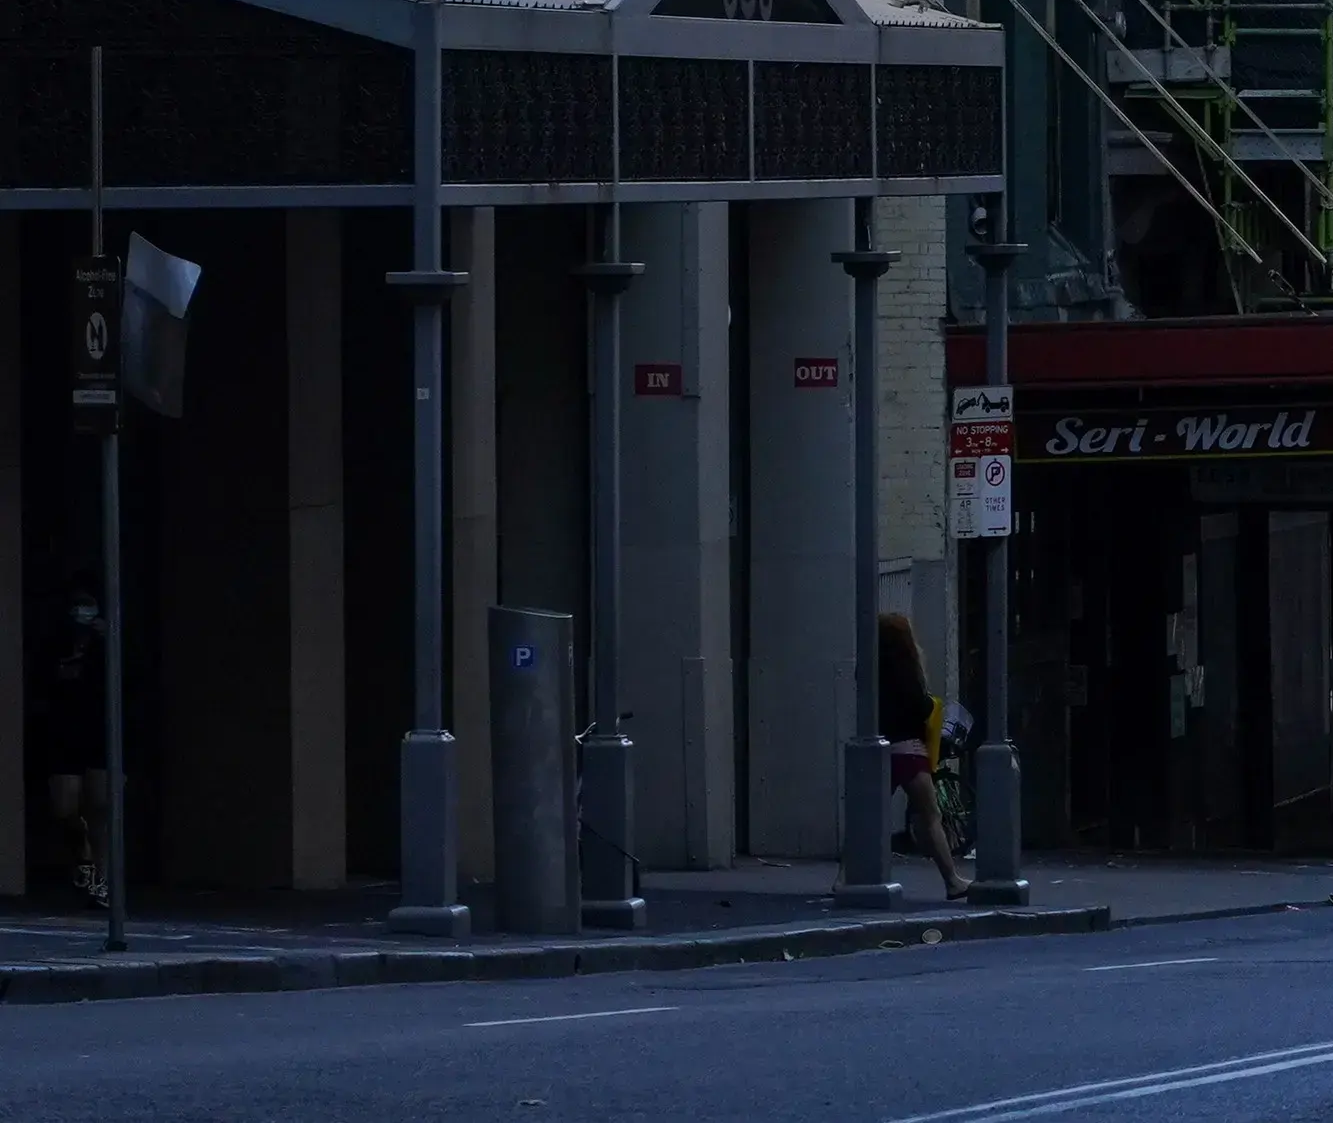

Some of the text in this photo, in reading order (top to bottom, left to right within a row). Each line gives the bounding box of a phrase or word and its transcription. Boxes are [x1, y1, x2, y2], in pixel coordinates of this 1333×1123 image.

[646, 372, 670, 388] IN
[796, 365, 836, 381] OUT
[956, 425, 1009, 435] NO STOPPING
[515, 648, 531, 666] P
